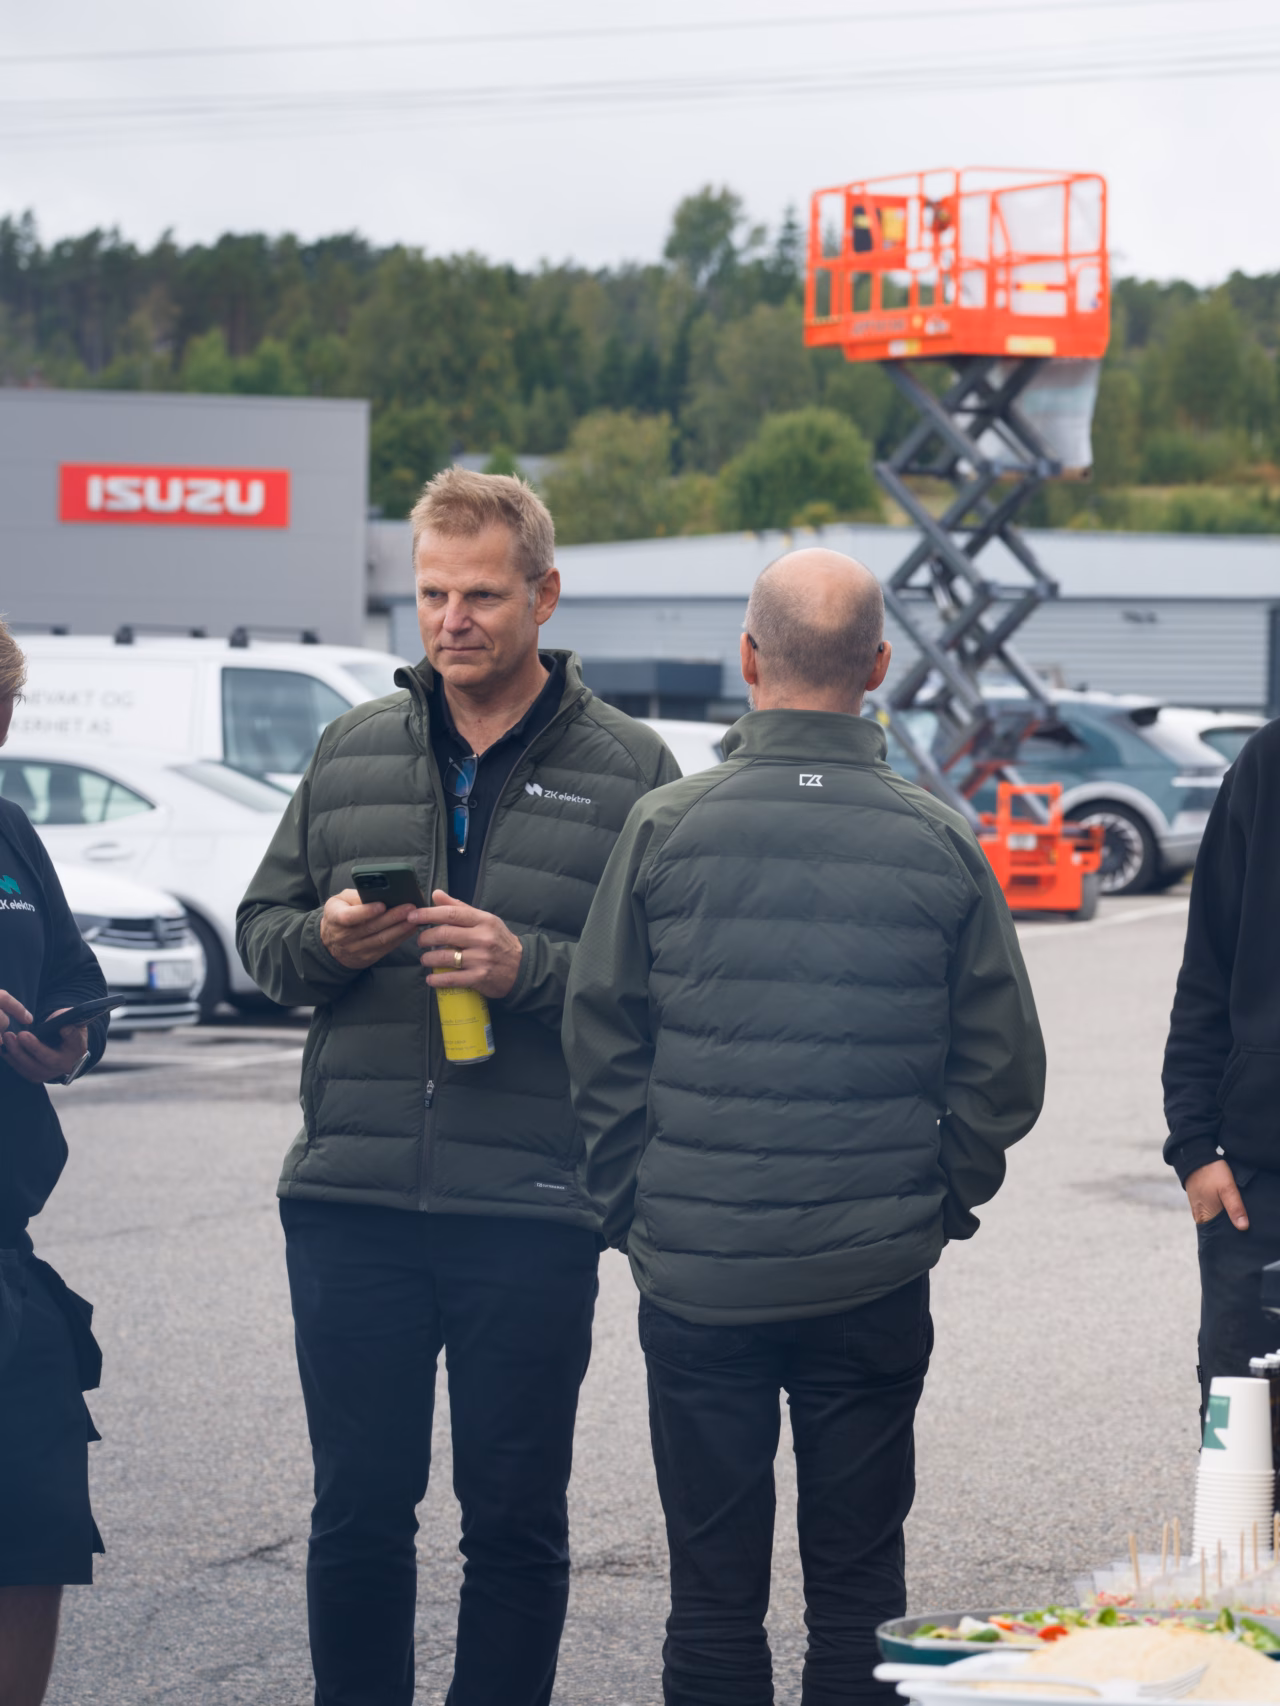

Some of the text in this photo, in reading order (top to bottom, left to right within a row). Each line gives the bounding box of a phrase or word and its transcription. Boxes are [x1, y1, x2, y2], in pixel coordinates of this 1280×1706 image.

[86, 474, 267, 517] ISUZU
[543, 789, 592, 805] ZK elektro
